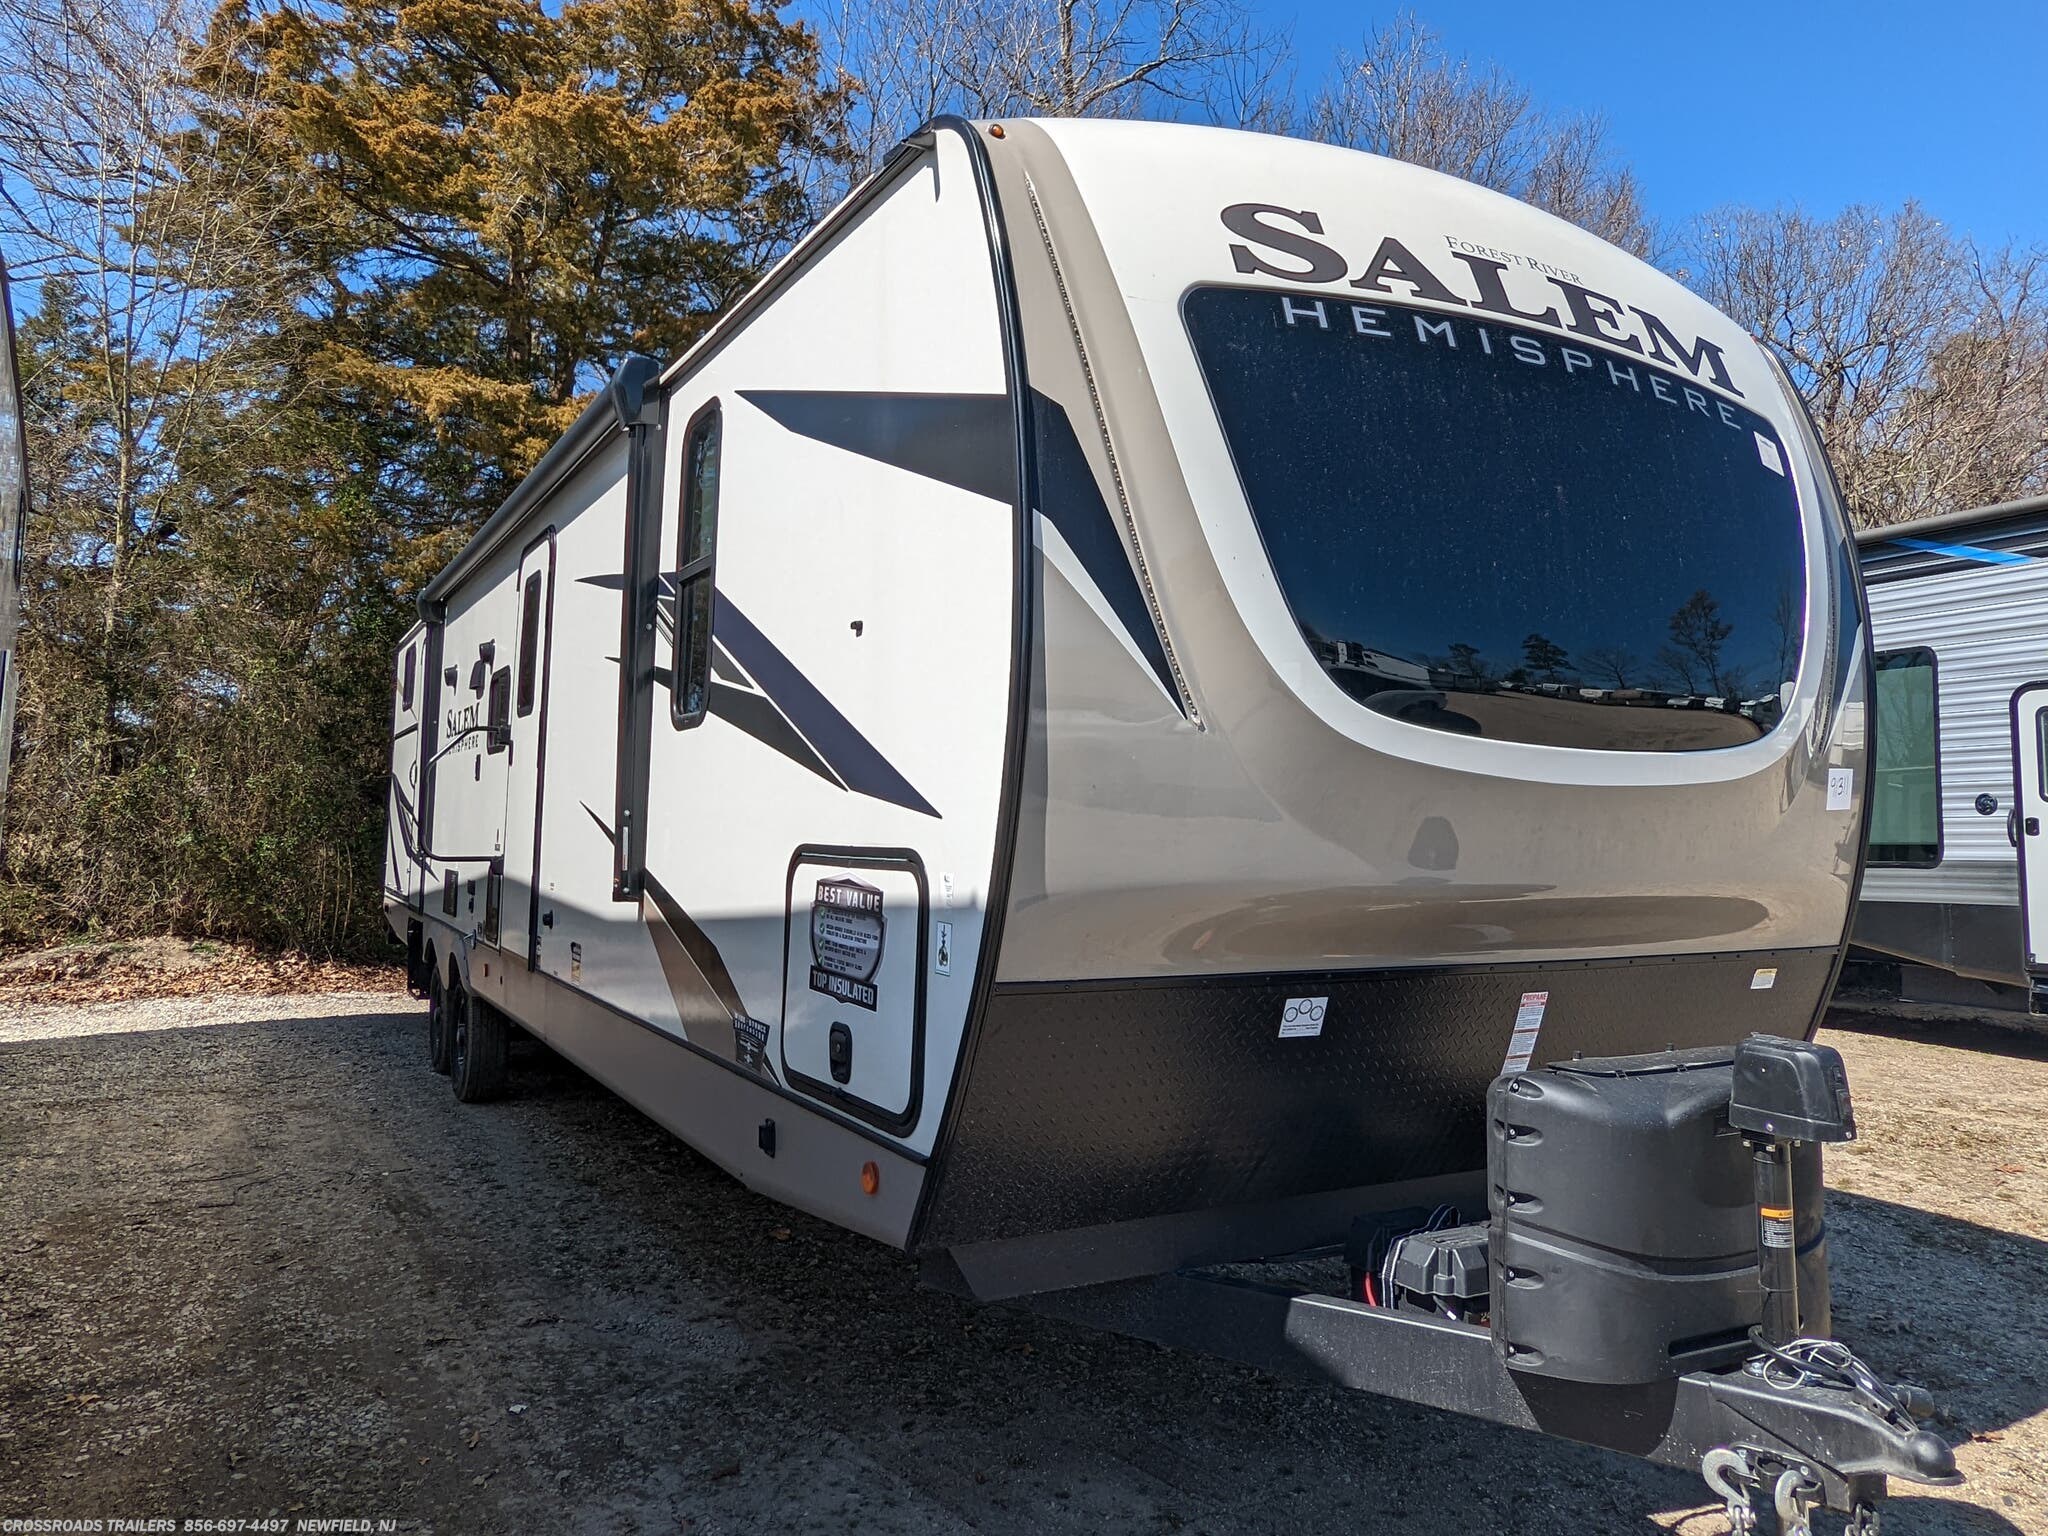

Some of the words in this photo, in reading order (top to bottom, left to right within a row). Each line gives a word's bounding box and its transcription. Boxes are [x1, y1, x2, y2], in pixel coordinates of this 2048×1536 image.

[1444, 235, 1522, 266] FOREST
[1526, 256, 1584, 285] RIVER
[1220, 202, 1745, 399] SALEM
[1281, 296, 1742, 430] HEMISPHERE
[446, 702, 480, 739] SALEM
[817, 885, 842, 904] BEST
[846, 891, 881, 912] VALUE
[812, 970, 828, 988] TOP
[828, 977, 875, 1005] INSULATED
